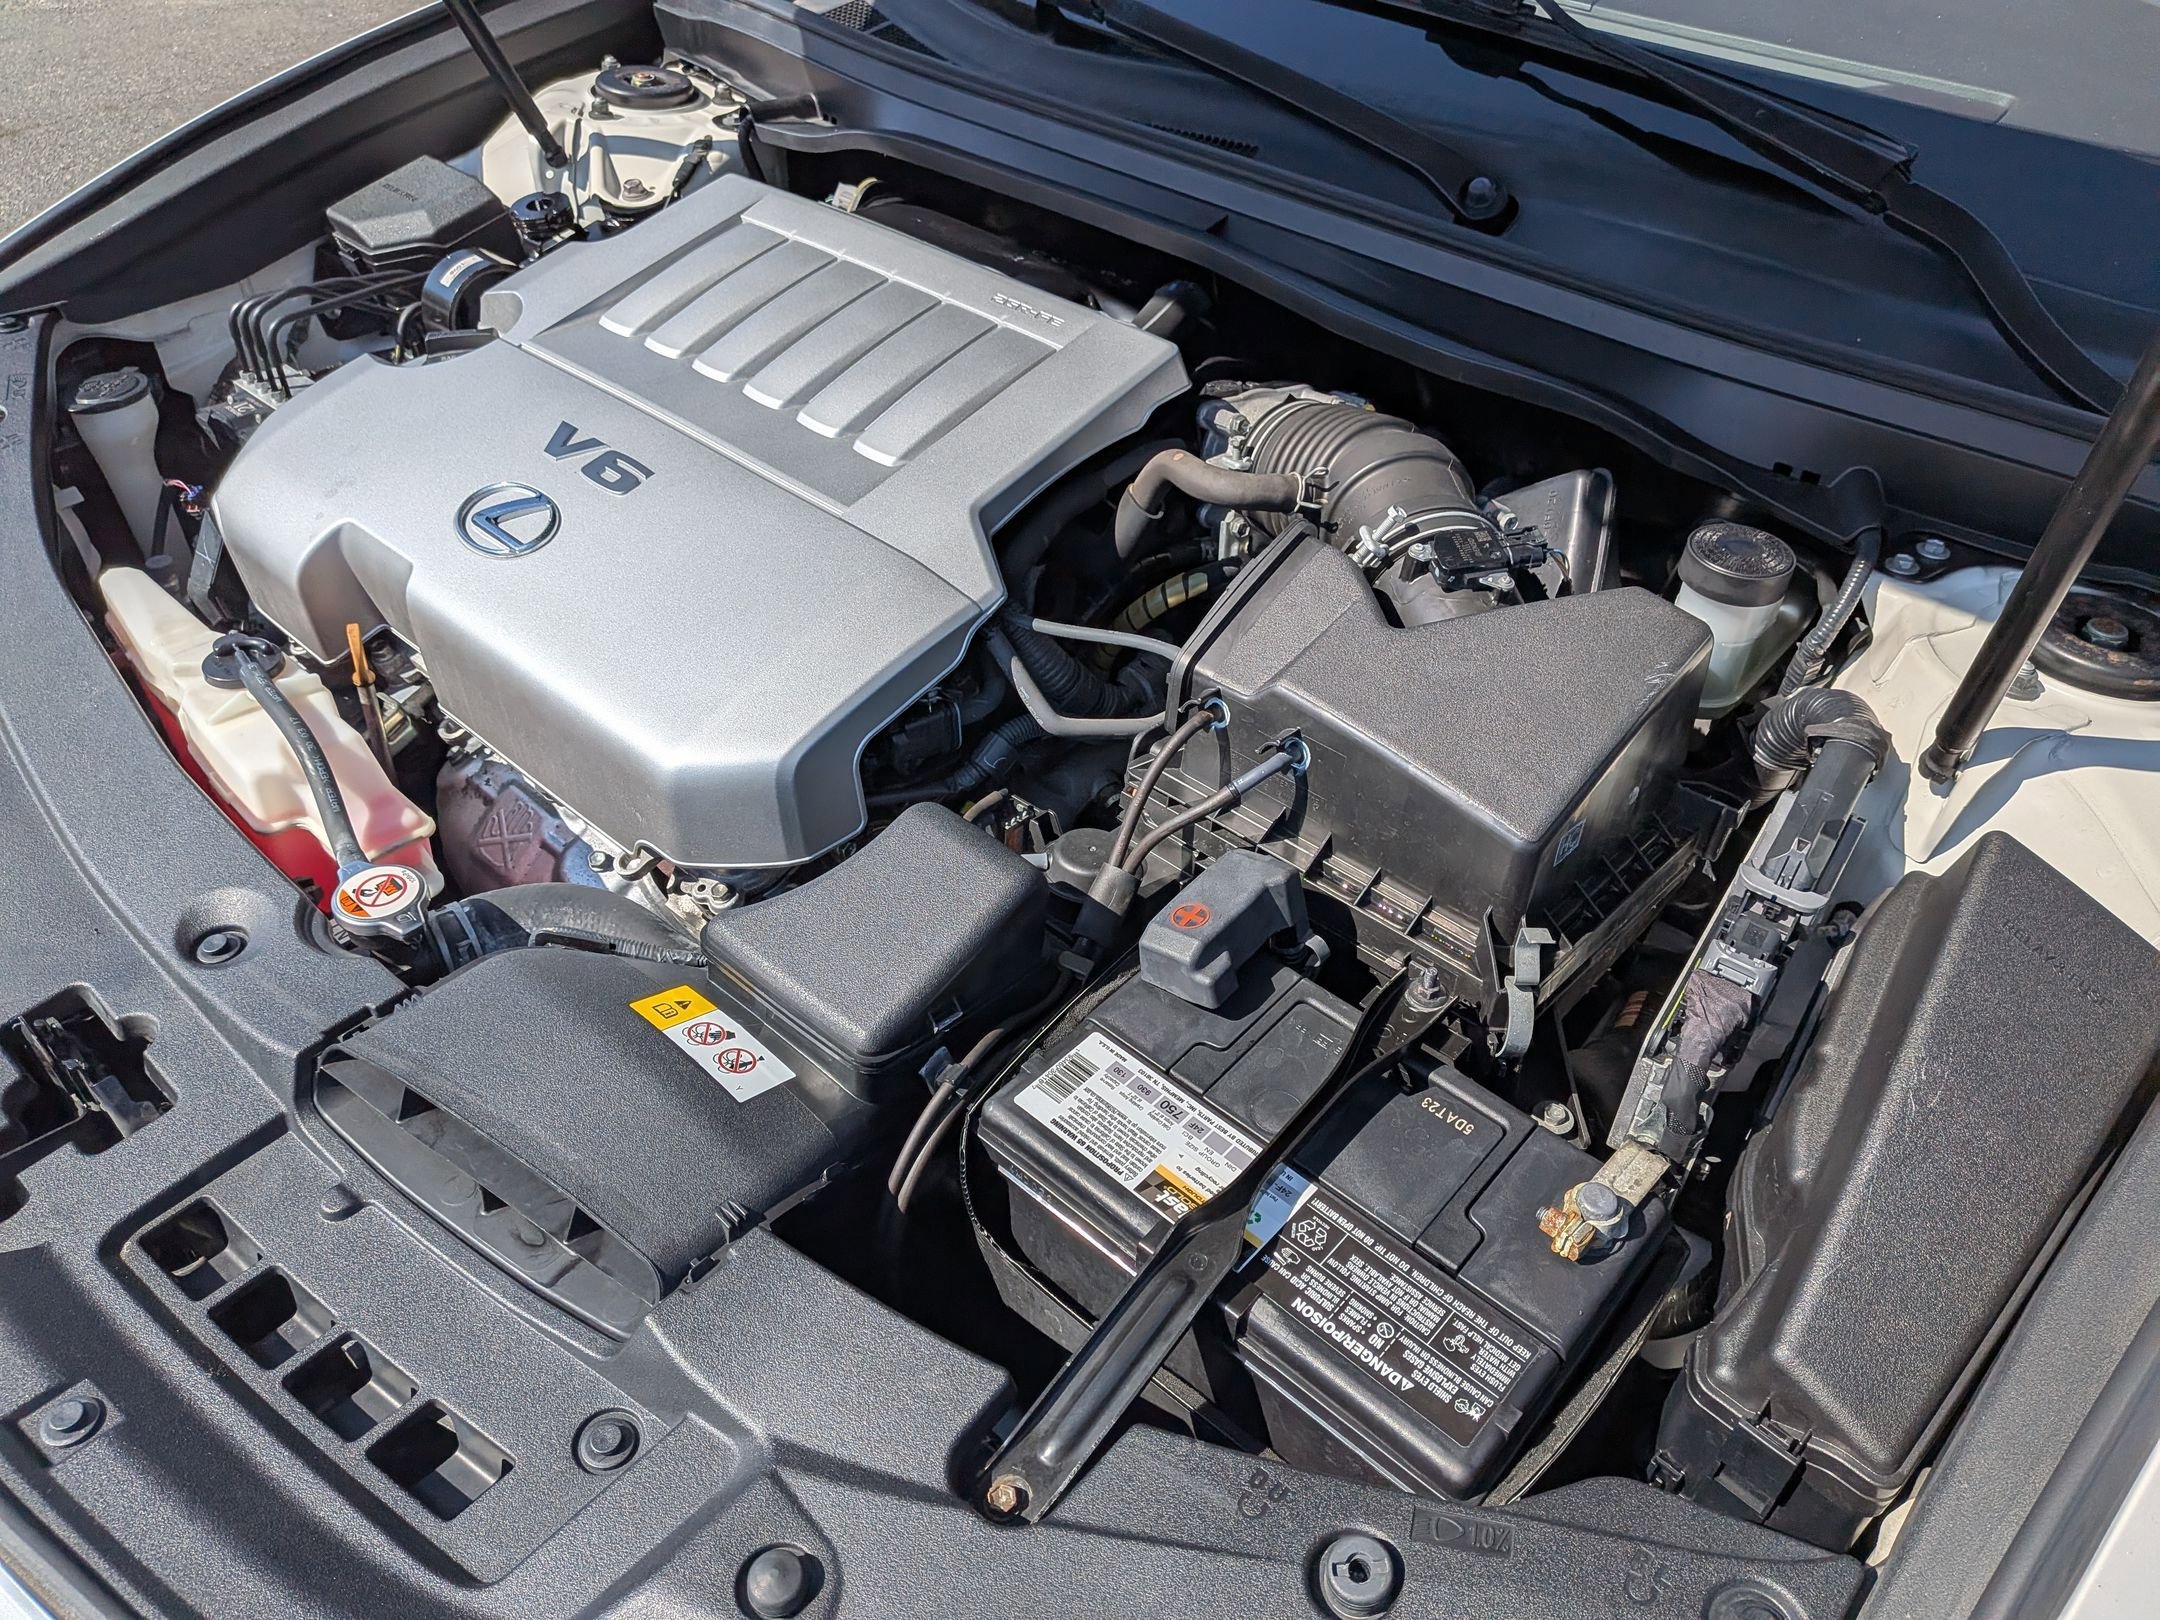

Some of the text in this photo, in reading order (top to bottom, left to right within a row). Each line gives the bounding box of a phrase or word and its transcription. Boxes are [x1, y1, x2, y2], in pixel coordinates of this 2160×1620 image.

[543, 419, 656, 496] V6
[1112, 1051, 1128, 1062] MADE
[1111, 1065, 1205, 1134] 24F 750 930 130
[1158, 1083, 1186, 1103] MEMPHIS,
[1194, 1109, 1217, 1125] PARTS,
[1212, 1122, 1229, 1134] BEST
[1421, 1097, 1475, 1136] 5DAT23
[1048, 1117, 1125, 1176] PROPOSITION 65 WARNING
[1180, 1130, 1238, 1172] DIN EN BCI
[1226, 1132, 1237, 1140] BY
[1183, 1140, 1221, 1168] GROUP SIZE
[1260, 1253, 1335, 1312] SULFURIC ACID CAN CAUSE
[1304, 1263, 1346, 1298] SEVERE BURNS
[1310, 1196, 1532, 1360] KEEP OUT OF THE REACH OF CHILDREN. DO NOT TIP. DO NOT OPEN BATTERY!
[1325, 1256, 1351, 1277] FOLLOW
[1344, 1260, 1370, 1281] OWNERS
[1299, 1271, 1340, 1305] BLINDNESS OR
[1348, 1253, 1441, 1324] MANUAL OR IF NOT AVAILABLE, SEEK
[1367, 1276, 1392, 1297] VEHICLE
[1373, 1291, 1393, 1308] JUMP
[1387, 1271, 1447, 1317] SERVICE ASSISTANCE.
[1337, 1311, 1363, 1333] SPARKS
[1343, 1304, 1369, 1326] FLAMES
[1347, 1296, 1375, 1320] SMOKING
[1389, 1303, 1404, 1316] FOR
[1394, 1297, 1436, 1330] INSTRUCTIONS
[1289, 1295, 1402, 1385] DANGER/POISON
[1366, 1332, 1386, 1350] NO
[1449, 1316, 1522, 1372] GET MEDICAL HELP FAST.
[1397, 1333, 1494, 1408] CAN CAUSE BLINDNESS OR INJURY
[1400, 1348, 1459, 1395] EXPLOSIVE GASES
[1468, 1362, 1507, 1392] FLUSH EYES
[1469, 1352, 1512, 1385] IMMEDIATELY
[1475, 1345, 1517, 1378] WITH WATER.
[1409, 1368, 1453, 1404] SHIELD EYES
